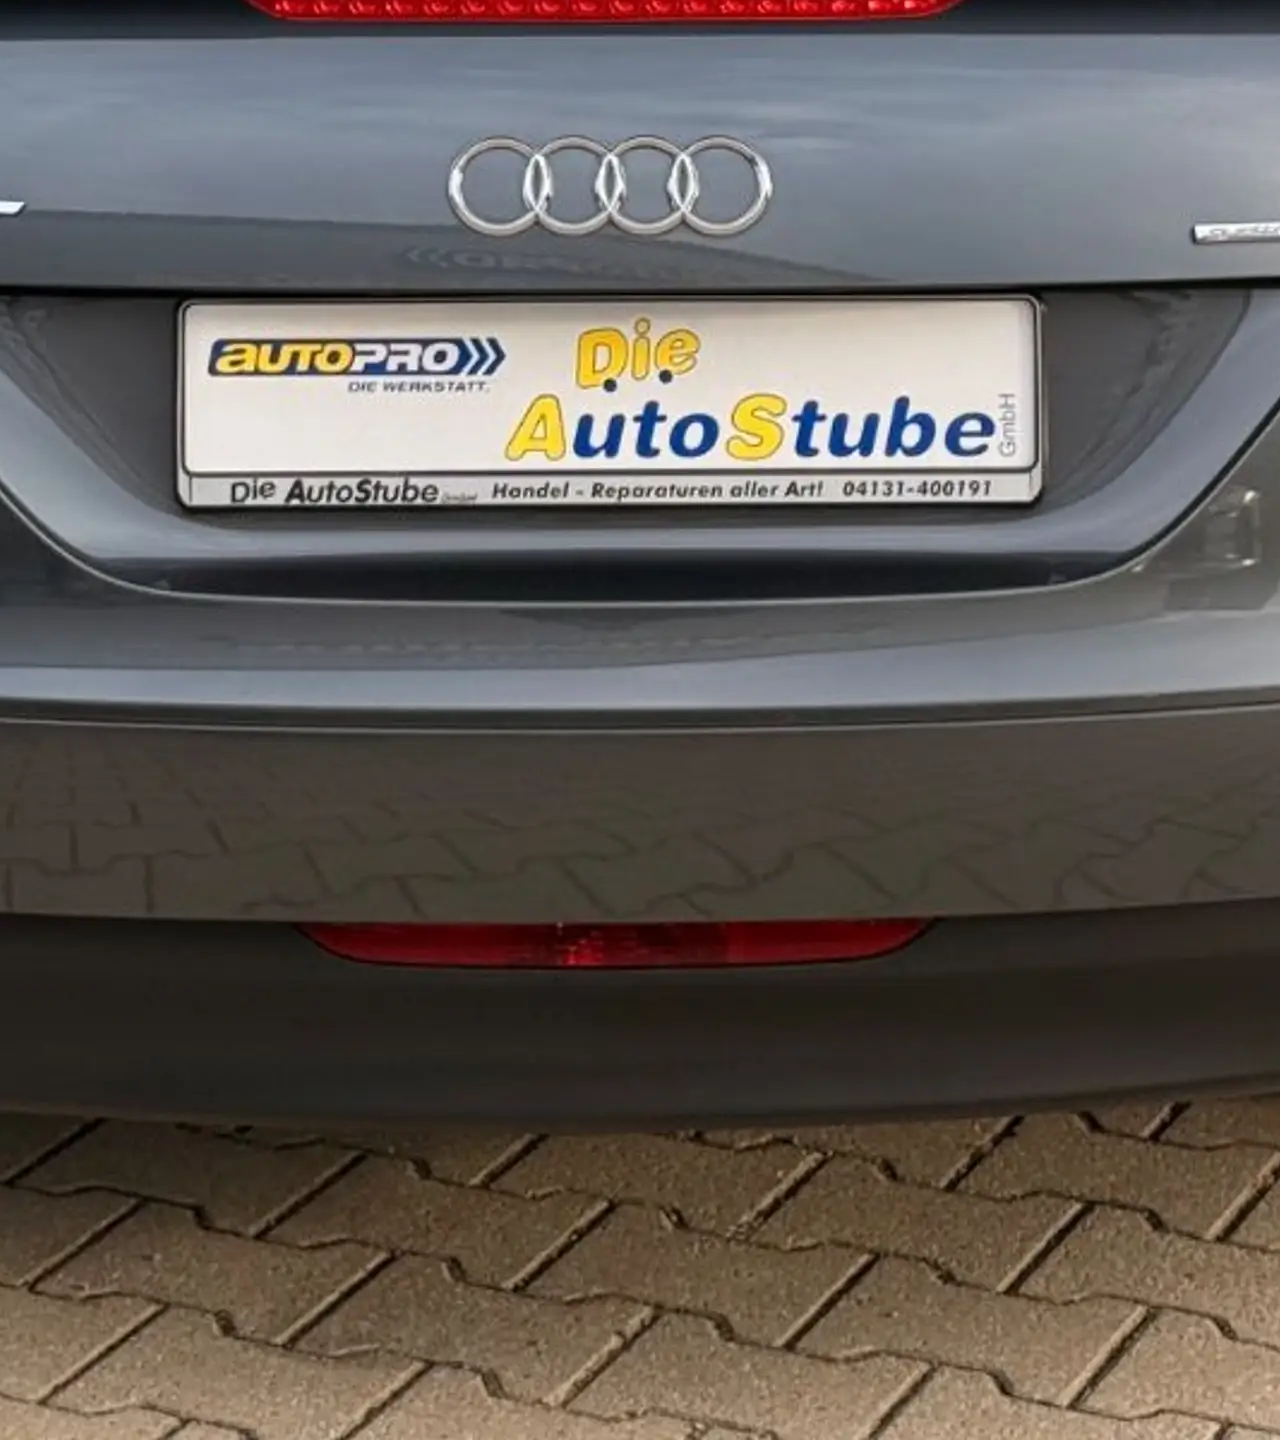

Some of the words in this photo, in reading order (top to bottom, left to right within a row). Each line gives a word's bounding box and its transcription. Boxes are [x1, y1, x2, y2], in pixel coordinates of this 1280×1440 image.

[575, 317, 701, 390] Die
[348, 381, 377, 393] DIE
[504, 392, 996, 462] AutoStube
[997, 392, 1016, 458] GmbH
[230, 478, 276, 504] Die
[284, 477, 439, 504] AutoStube
[491, 481, 569, 499] Handel
[591, 481, 723, 501] Reparaturen
[730, 480, 779, 498] aller
[784, 480, 824, 498] Art!
[842, 479, 992, 497] 04131-400191
